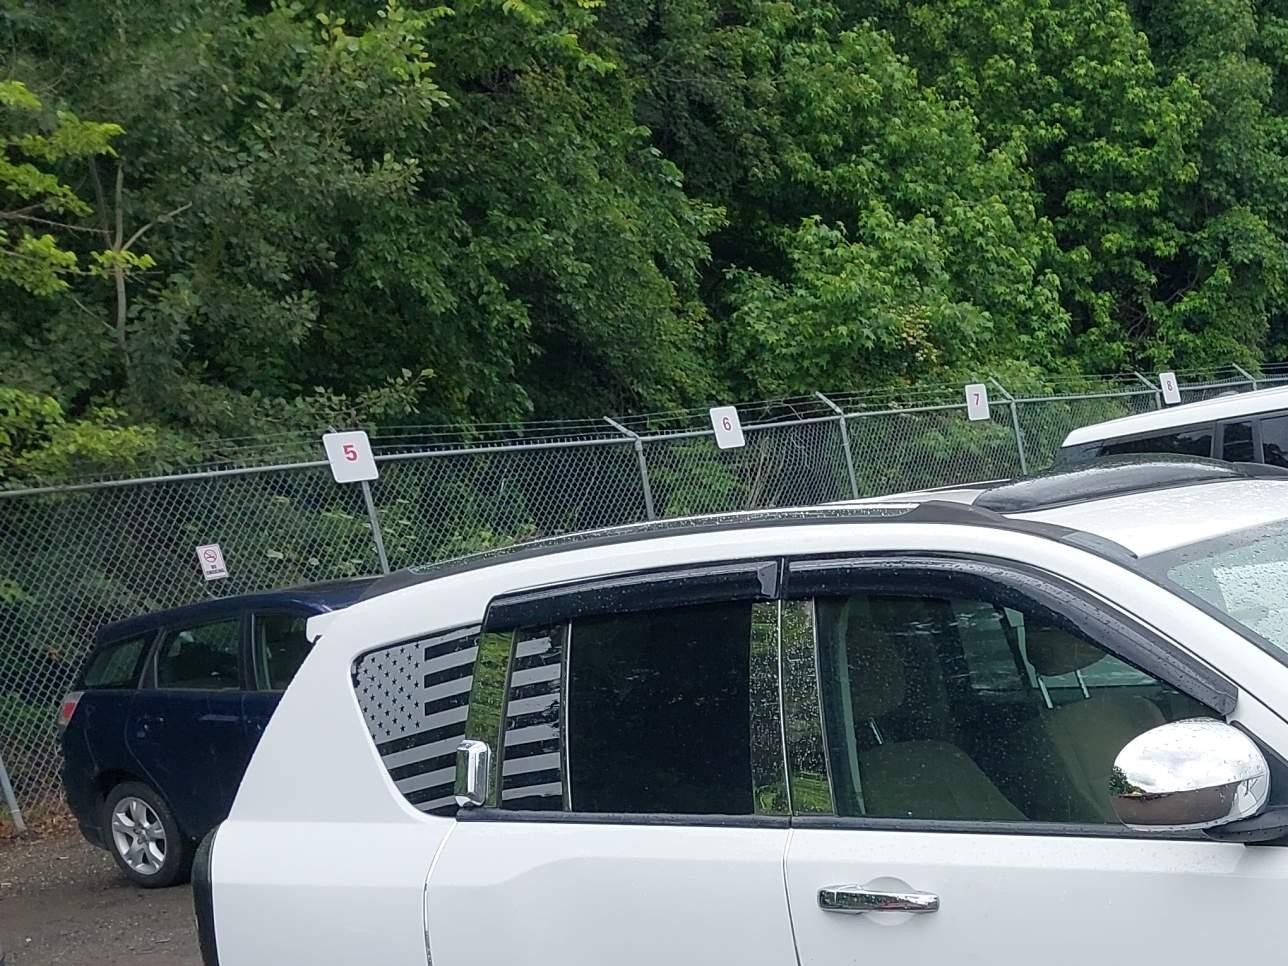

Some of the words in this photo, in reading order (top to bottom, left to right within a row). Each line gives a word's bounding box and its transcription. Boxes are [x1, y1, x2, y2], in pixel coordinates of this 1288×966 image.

[973, 392, 980, 406] 7
[722, 416, 732, 431] 6
[342, 444, 358, 461] 5
